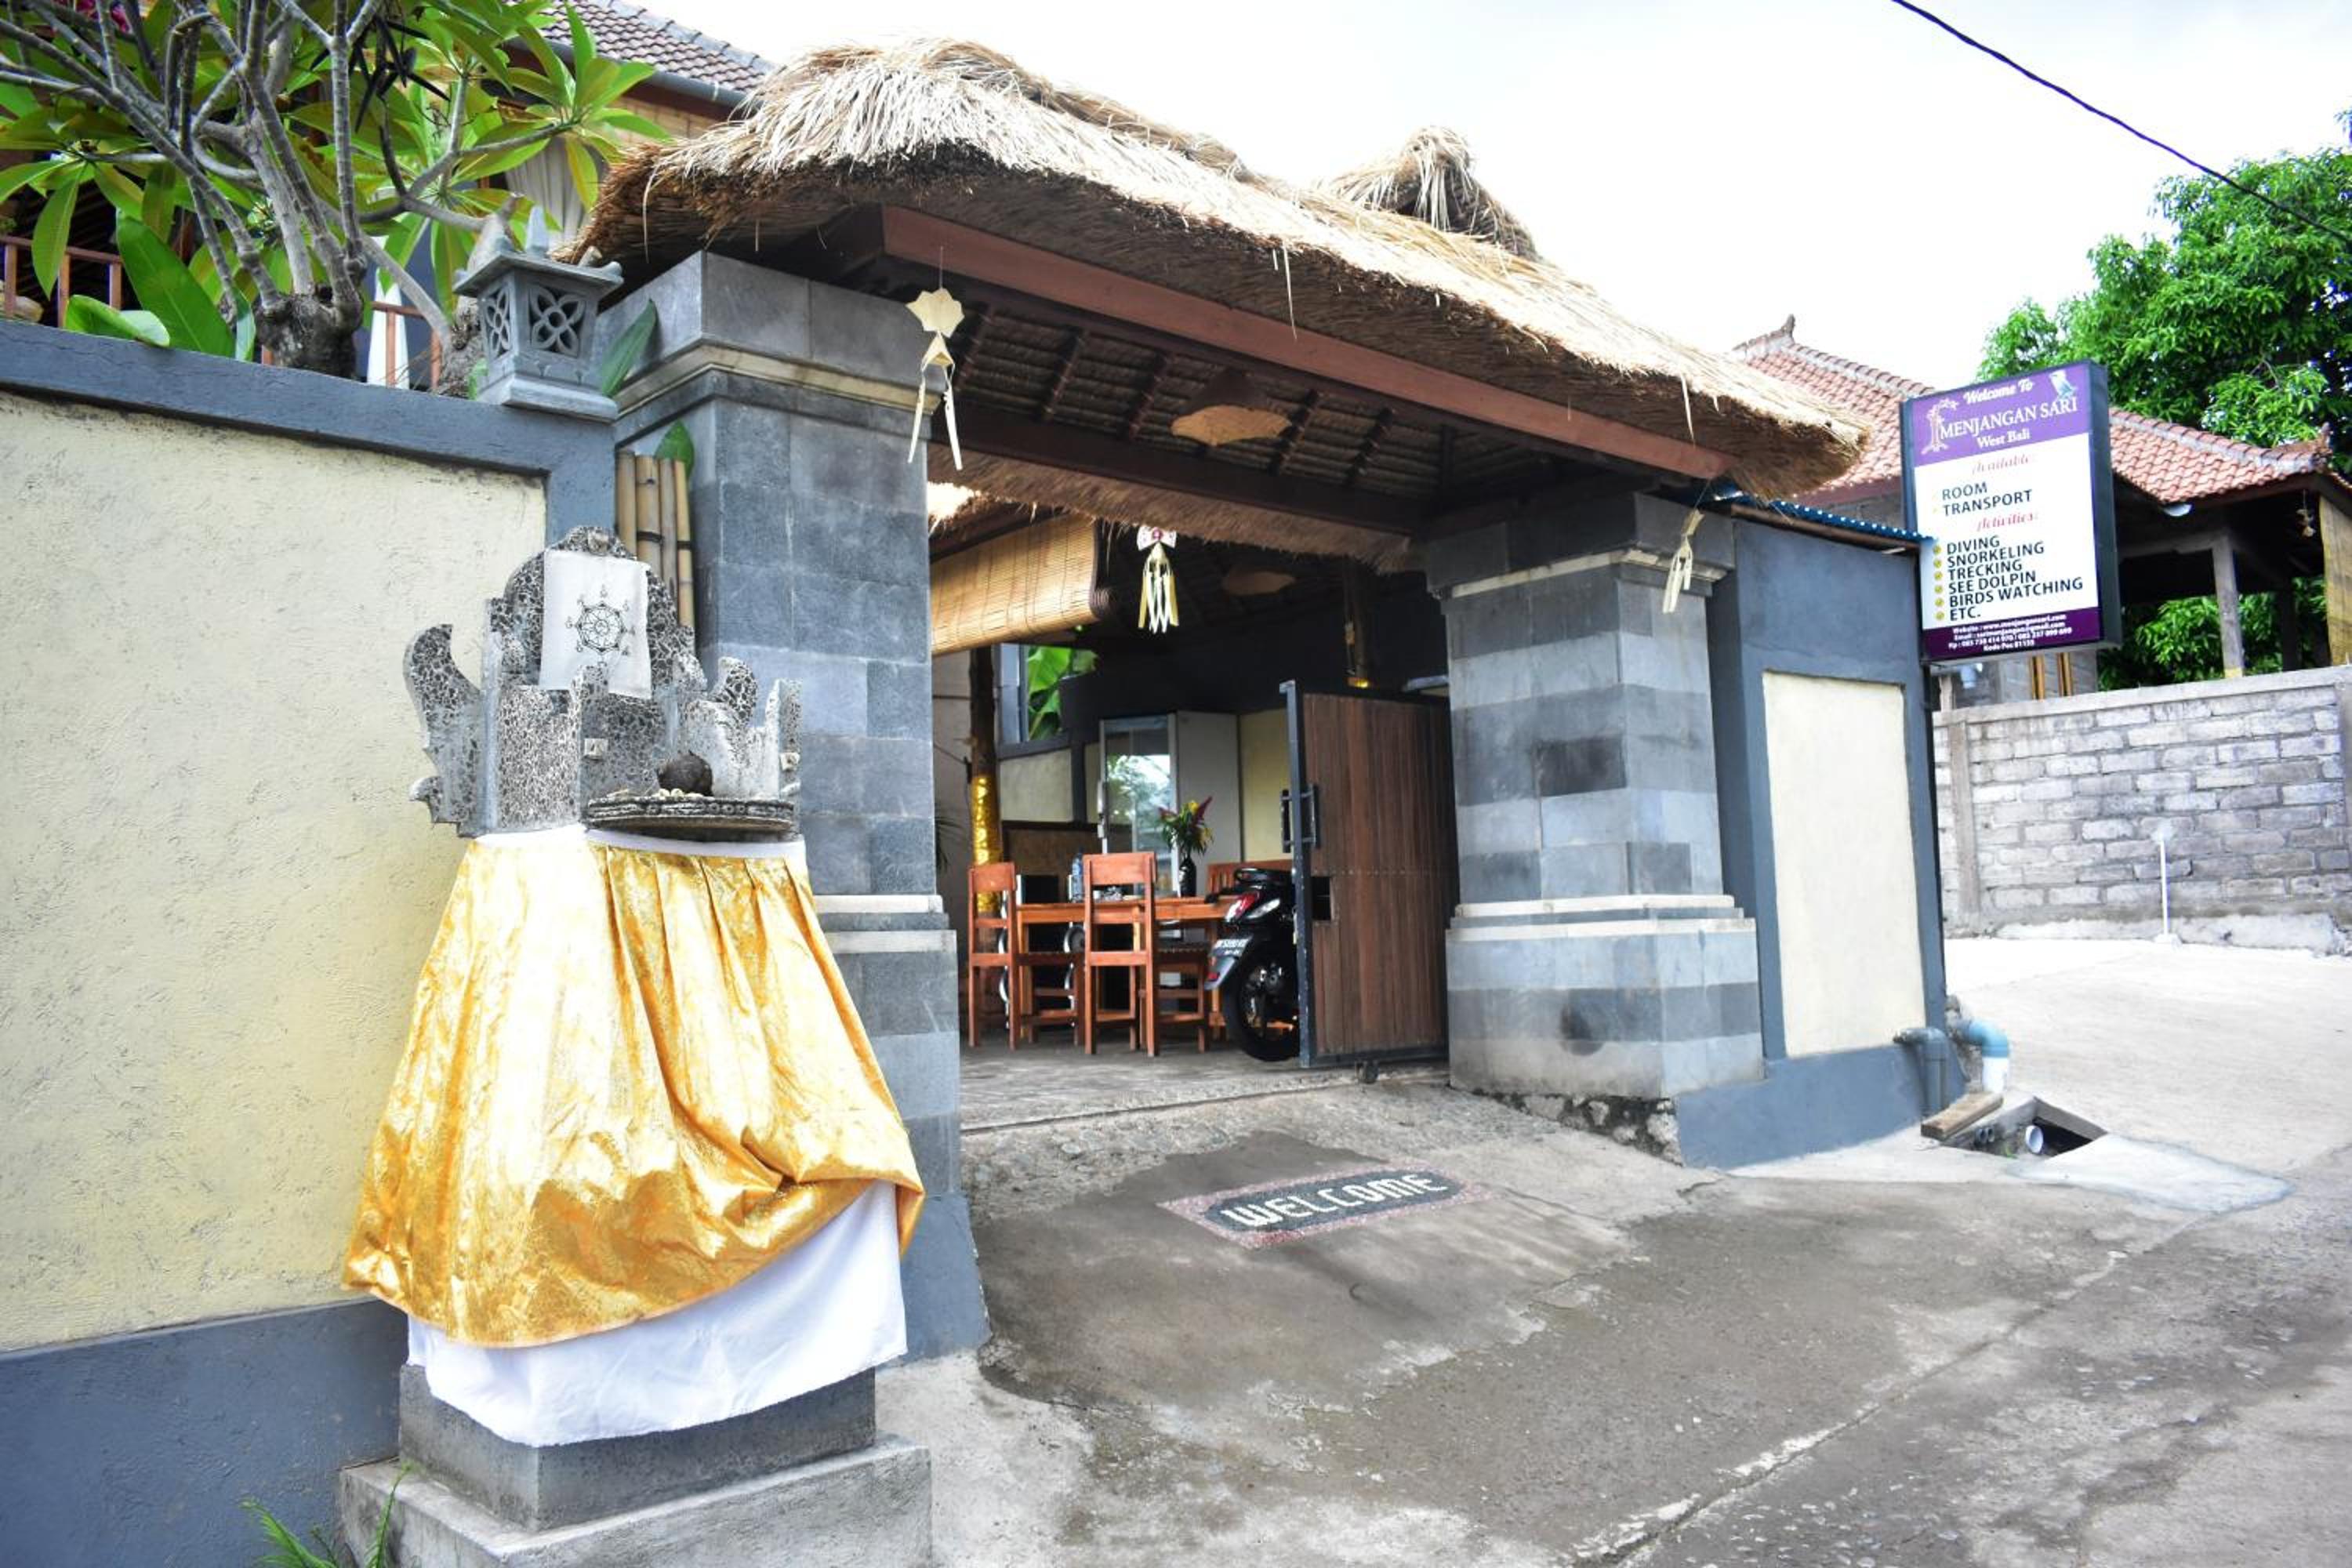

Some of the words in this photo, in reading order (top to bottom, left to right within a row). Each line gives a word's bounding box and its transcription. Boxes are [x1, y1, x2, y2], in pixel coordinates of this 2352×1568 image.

[1963, 384, 2016, 405] Welcome
[2018, 379, 2034, 391] To
[1940, 405, 2037, 439] MENJANGAN
[2040, 397, 2078, 418] SARI
[1976, 434, 2005, 449] West
[2006, 428, 2030, 445] Bali
[1942, 481, 1987, 500] ROOM
[1944, 489, 2032, 516] TRANSPORT
[1947, 535, 2000, 555] DIVING
[1947, 541, 2045, 568] SNORKELING
[1947, 559, 2023, 581] TRECKING
[1948, 580, 1973, 595] SEE
[1979, 571, 2035, 590] DOLPIN
[1950, 590, 1994, 608] BIRDS
[1998, 577, 2083, 601] WATCHING
[1950, 607, 1981, 621] ETC.
[1221, 1174, 1447, 1227] WELCOME
